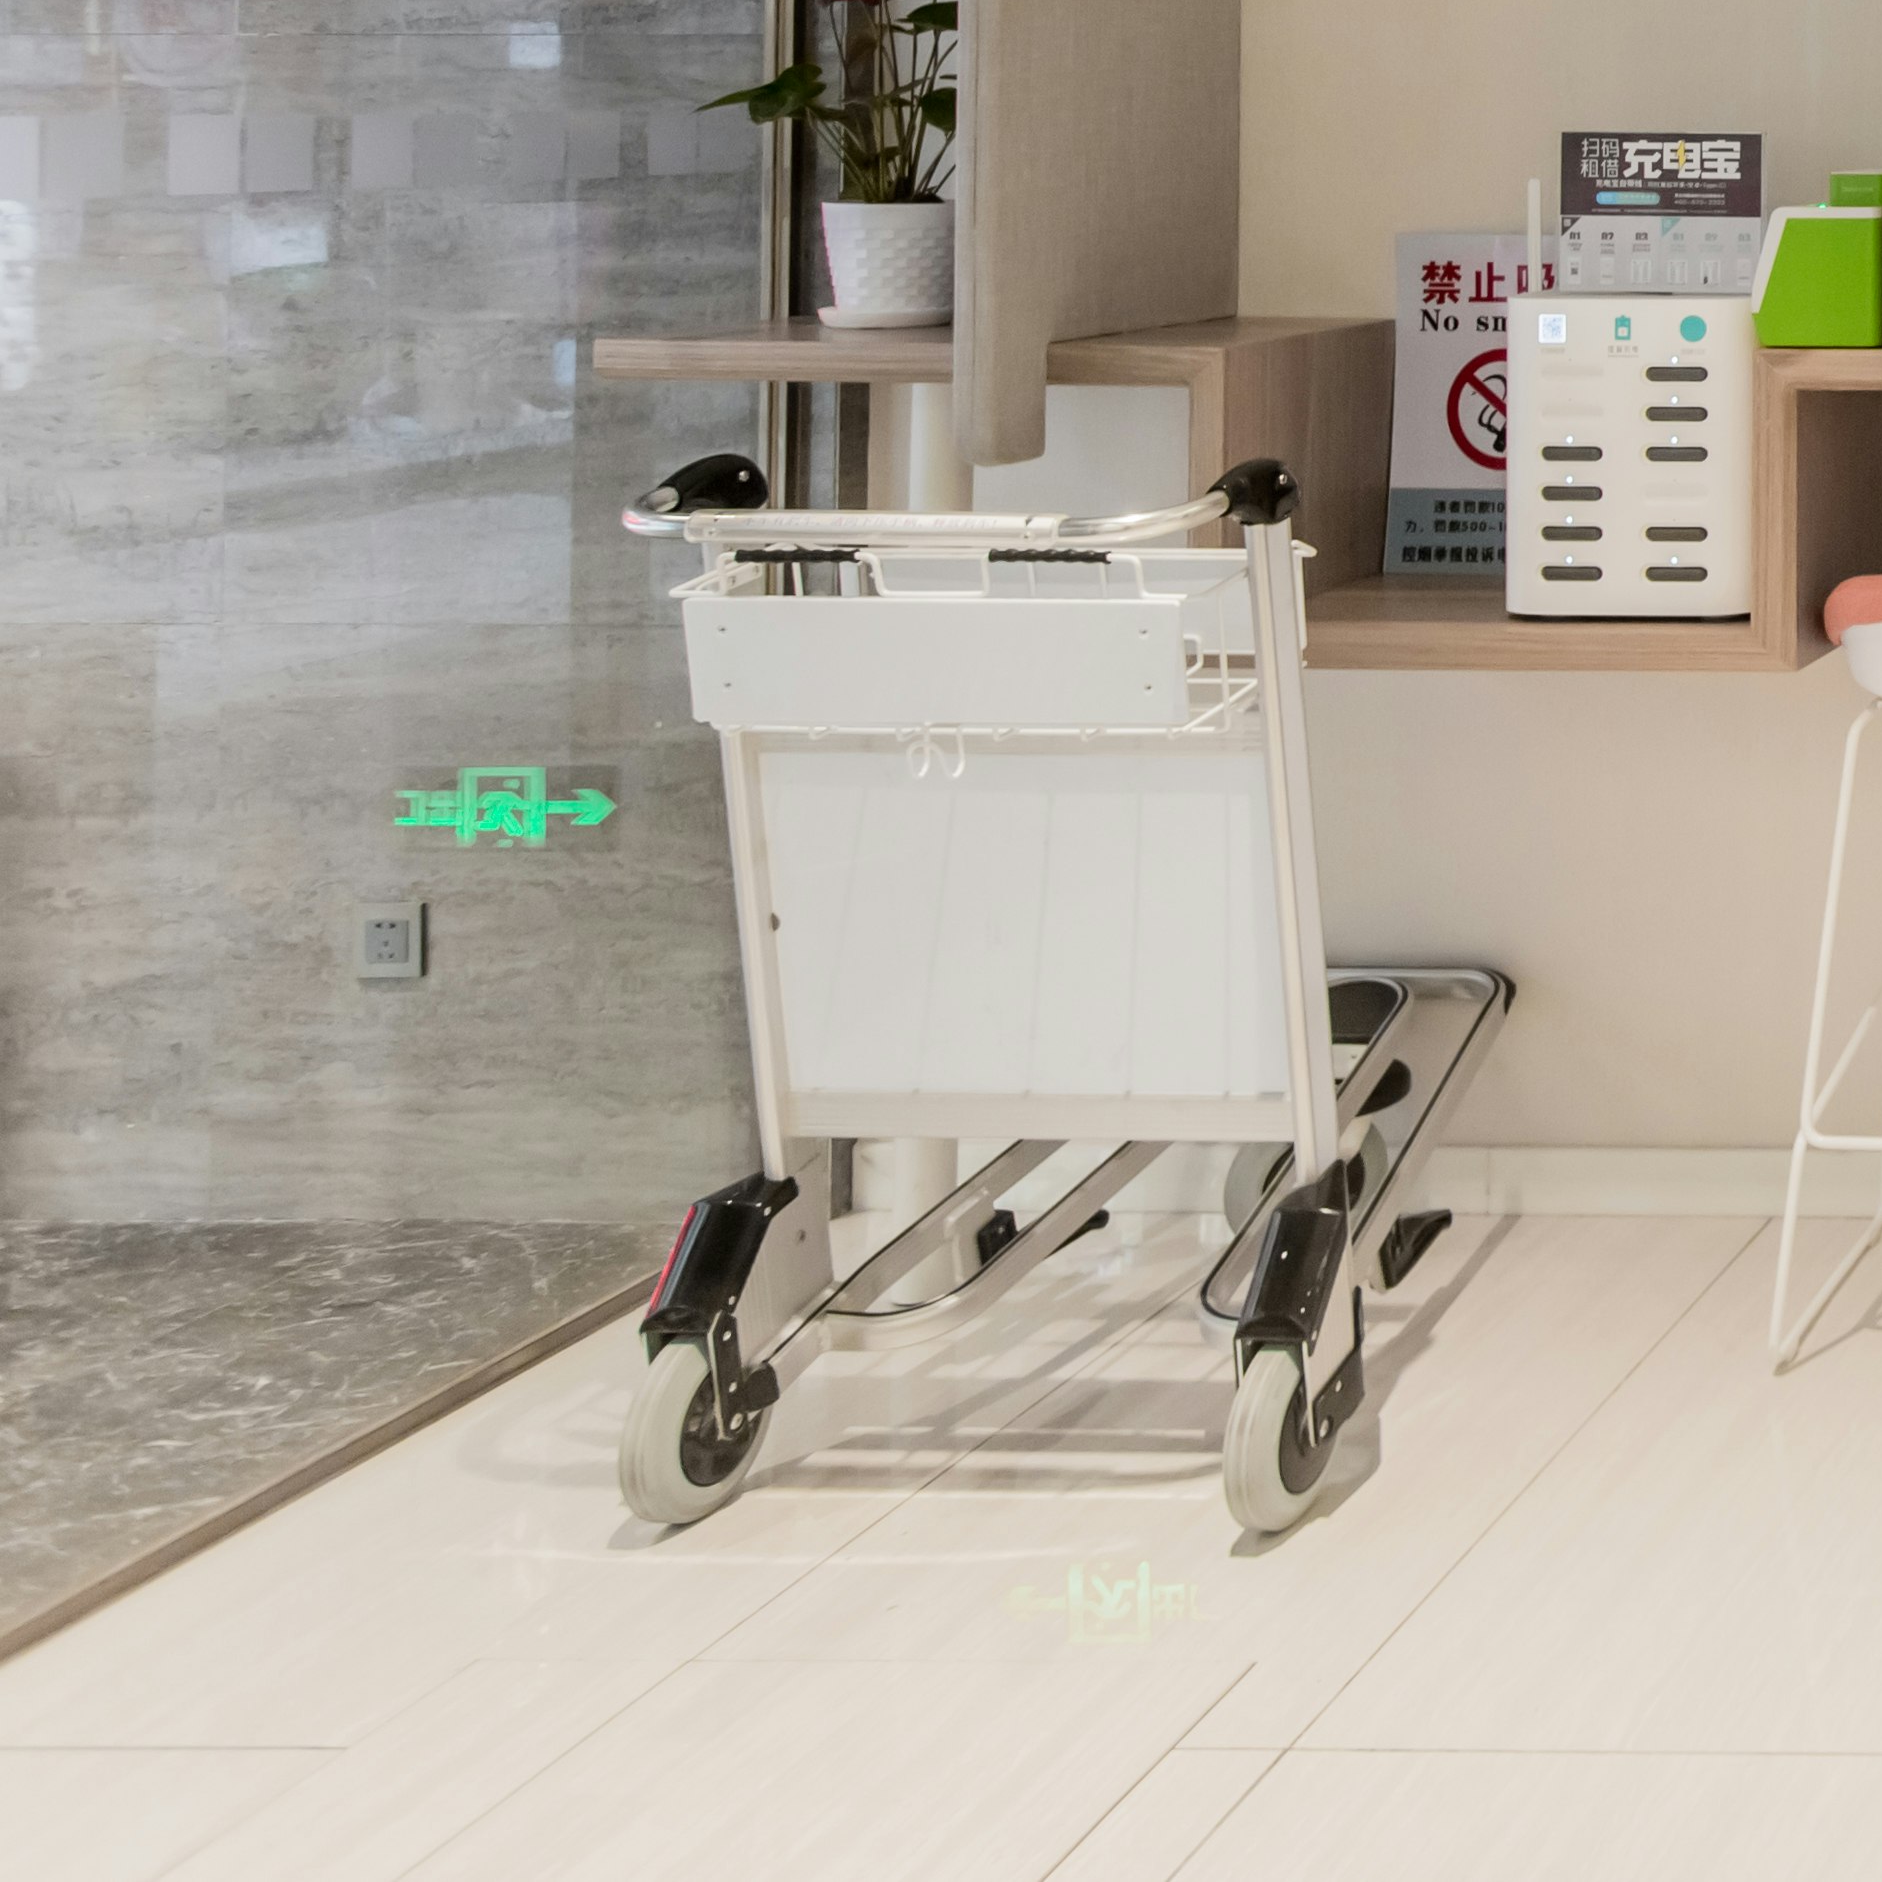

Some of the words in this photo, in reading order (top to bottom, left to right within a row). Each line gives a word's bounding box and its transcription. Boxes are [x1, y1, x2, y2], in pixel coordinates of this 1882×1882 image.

[1581, 137, 1620, 158] 扫码
[1580, 159, 1620, 178] 租借
[1622, 139, 1742, 179] 充电宝
[1420, 309, 1460, 332] No
